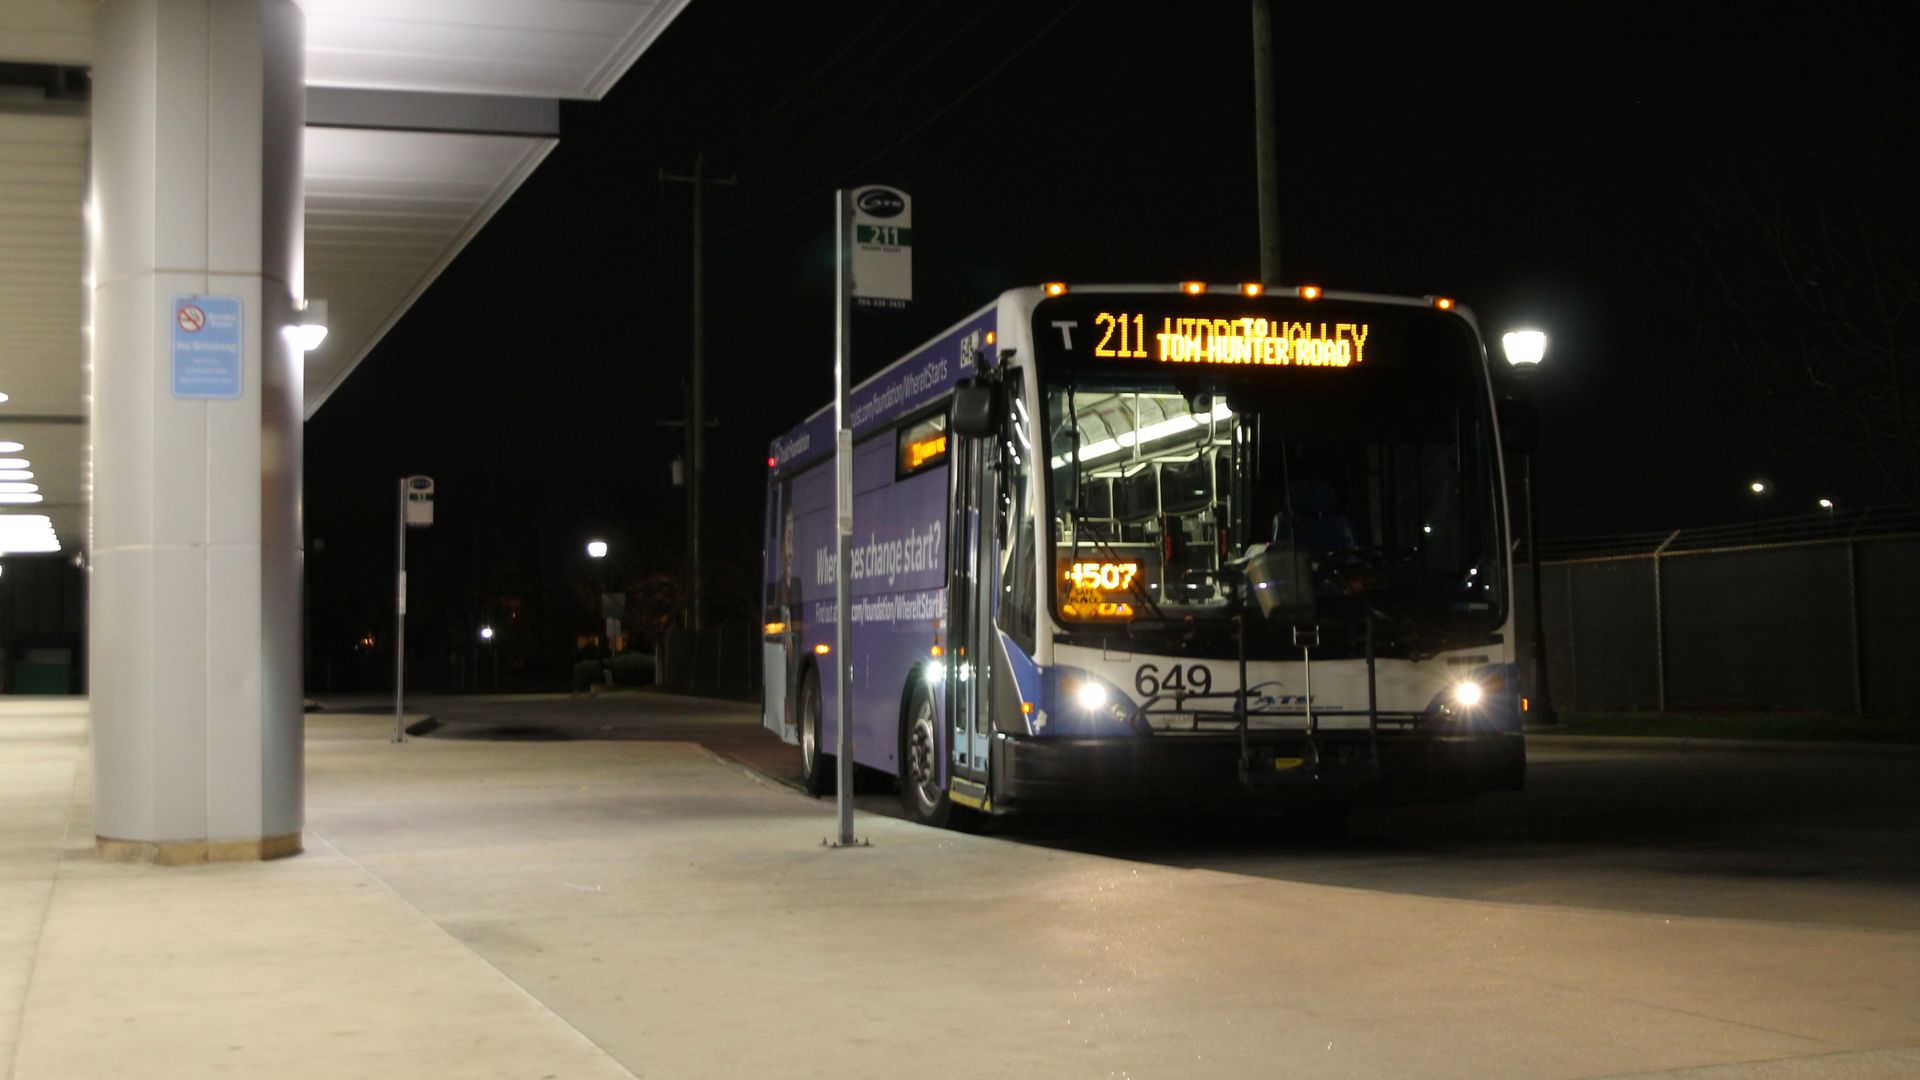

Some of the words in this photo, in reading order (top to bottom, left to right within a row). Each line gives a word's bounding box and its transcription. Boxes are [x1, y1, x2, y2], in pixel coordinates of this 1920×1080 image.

[870, 226, 899, 246] 211
[1051, 320, 1078, 351] T
[1094, 312, 1148, 358] 211
[1240, 317, 1268, 338] TO
[1156, 333, 1202, 362] TOM
[1207, 334, 1290, 365] HUNTER
[1295, 337, 1351, 367] ROAD
[816, 546, 840, 587] Wher
[866, 533, 902, 586] change
[904, 520, 941, 573] start?
[1135, 663, 1213, 698] 649
